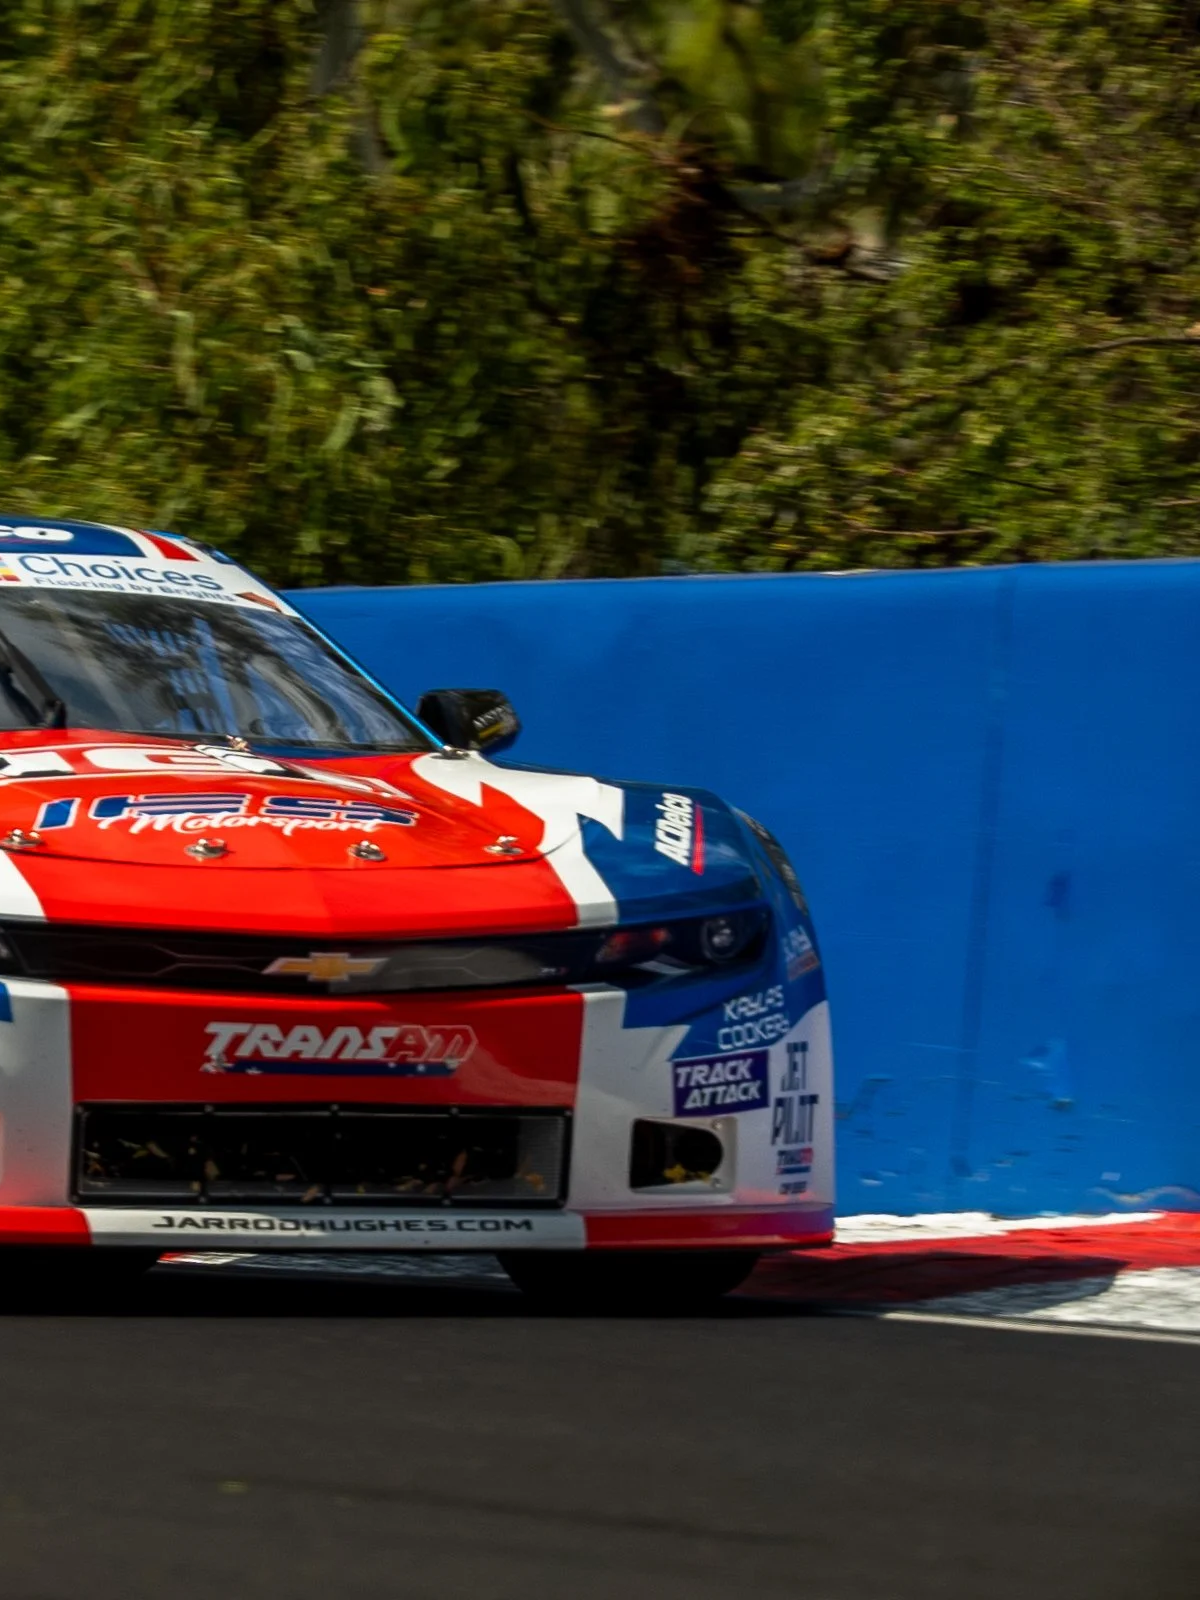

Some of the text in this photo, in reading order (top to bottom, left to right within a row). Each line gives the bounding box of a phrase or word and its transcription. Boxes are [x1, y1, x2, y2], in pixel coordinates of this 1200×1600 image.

[18, 555, 225, 591] Choices
[33, 577, 236, 602] Flooring by Brights
[97, 812, 385, 837] Motorsport
[654, 792, 693, 866] ACDelco
[676, 1058, 753, 1088] TRACK
[684, 1079, 763, 1109] ATTACK
[153, 1215, 533, 1232] JARRODHUGHES.COM
